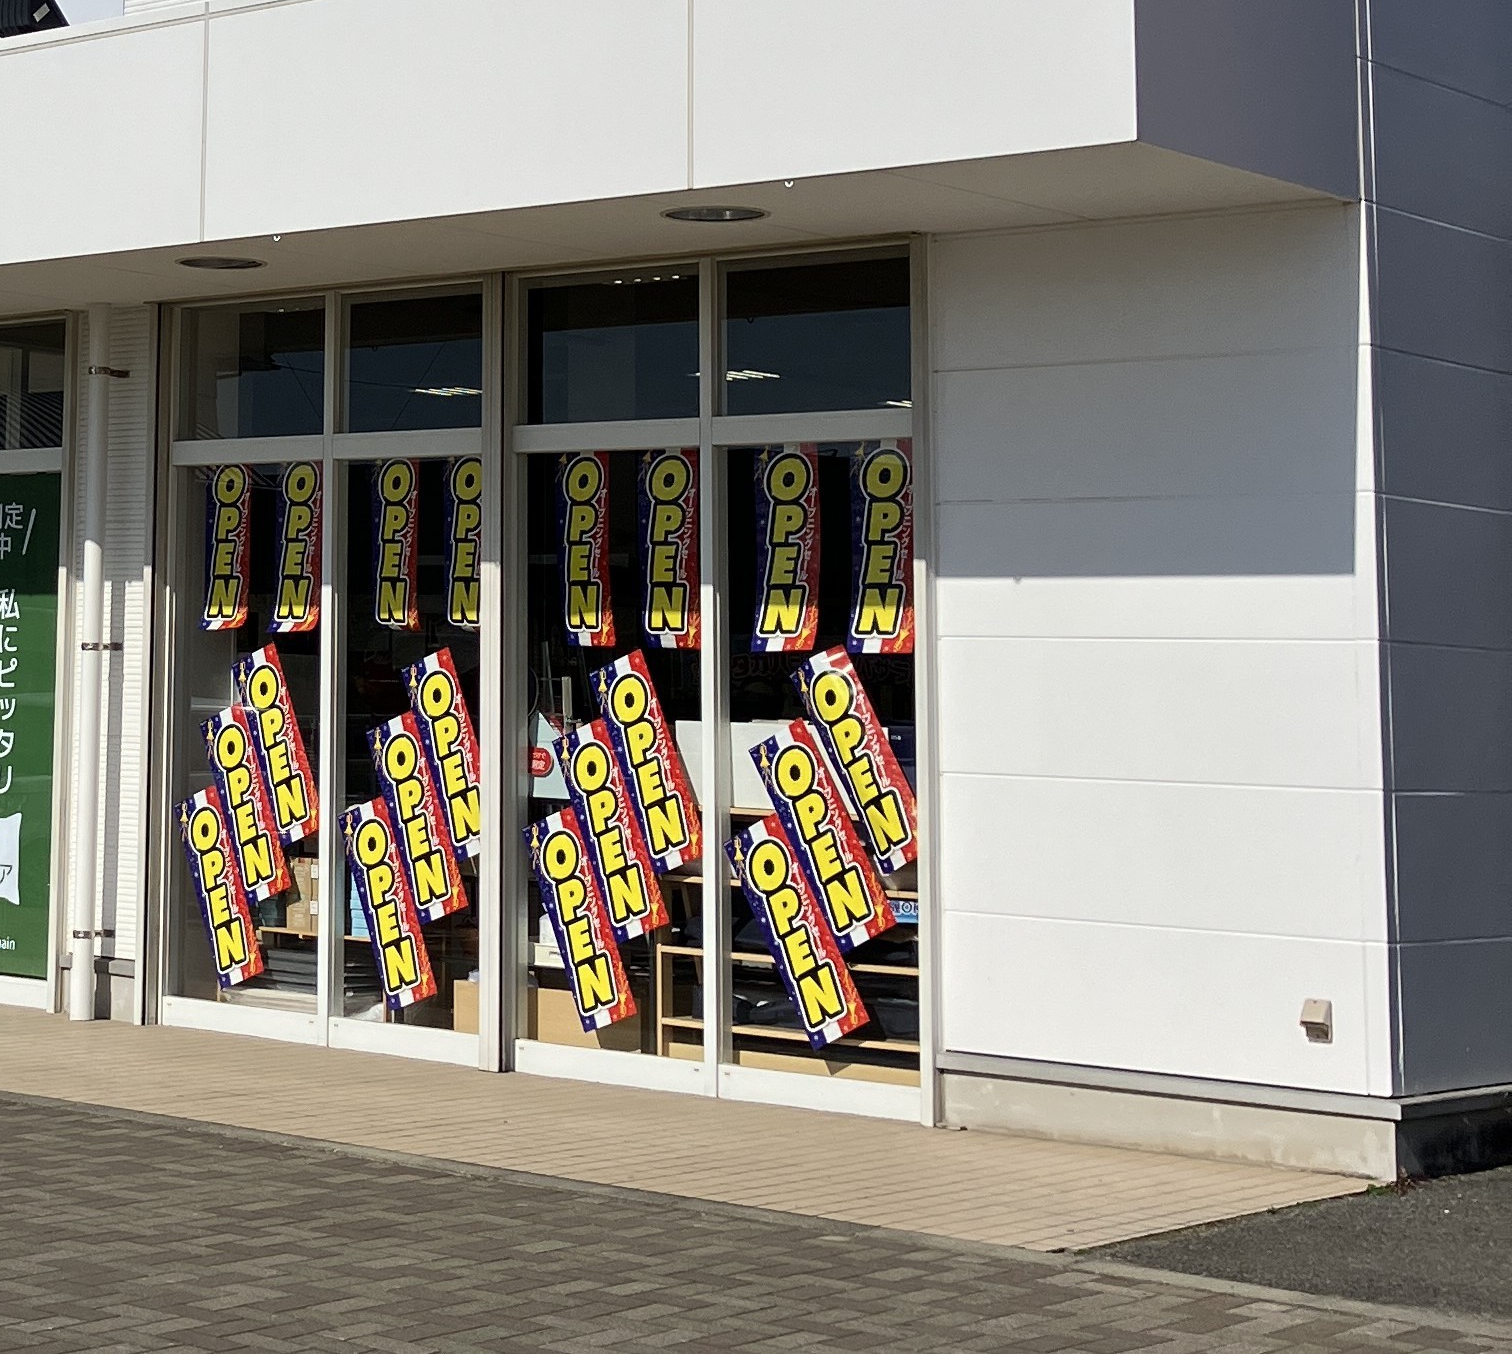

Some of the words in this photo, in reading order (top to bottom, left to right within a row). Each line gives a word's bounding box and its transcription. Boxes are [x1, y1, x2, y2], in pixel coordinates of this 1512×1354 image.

[207, 464, 246, 621] OPEN
[277, 464, 318, 621] OPEN
[376, 460, 414, 624] OPEN
[448, 459, 481, 624] OPEN
[565, 459, 602, 630] OPEN
[647, 457, 689, 633] OPEN
[760, 456, 809, 636] OPEN
[855, 453, 907, 636] OPEN
[214, 726, 275, 888] OPEN
[247, 666, 310, 828] OPEN
[383, 735, 449, 906] OPEN
[419, 672, 481, 842] OPEN
[610, 676, 686, 855] OPEN
[811, 673, 907, 854] OPEN
[189, 808, 248, 972] OPEN
[354, 821, 419, 991] OPEN
[572, 744, 648, 924] OPEN
[774, 747, 870, 932] OPEN
[542, 832, 615, 1010] OPEN
[748, 841, 844, 1026] OPEN
